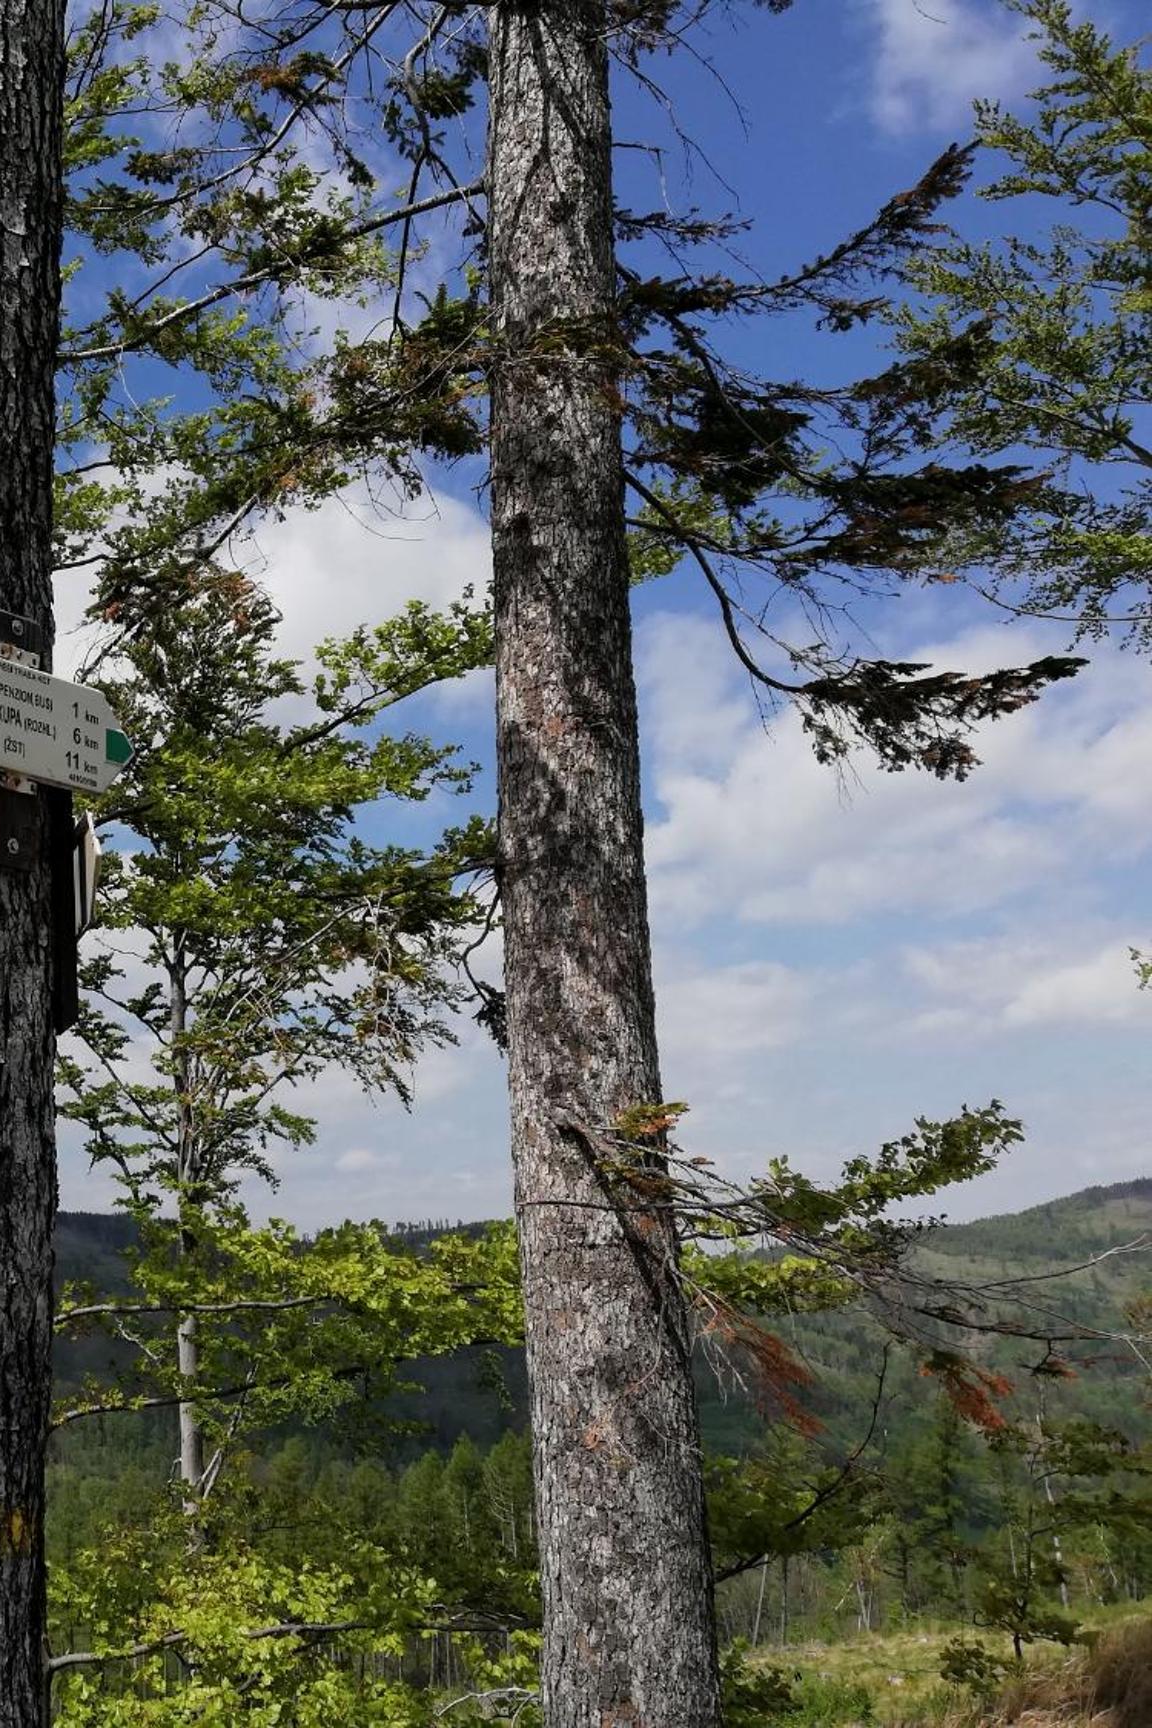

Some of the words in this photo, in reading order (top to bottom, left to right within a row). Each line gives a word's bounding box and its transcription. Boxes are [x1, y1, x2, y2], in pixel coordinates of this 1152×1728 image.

[71, 702, 79, 719] 1
[85, 709, 99, 725] km
[73, 728, 81, 745] 6
[84, 735, 99, 750] km
[65, 751, 80, 770] 11
[84, 760, 98, 775] km
